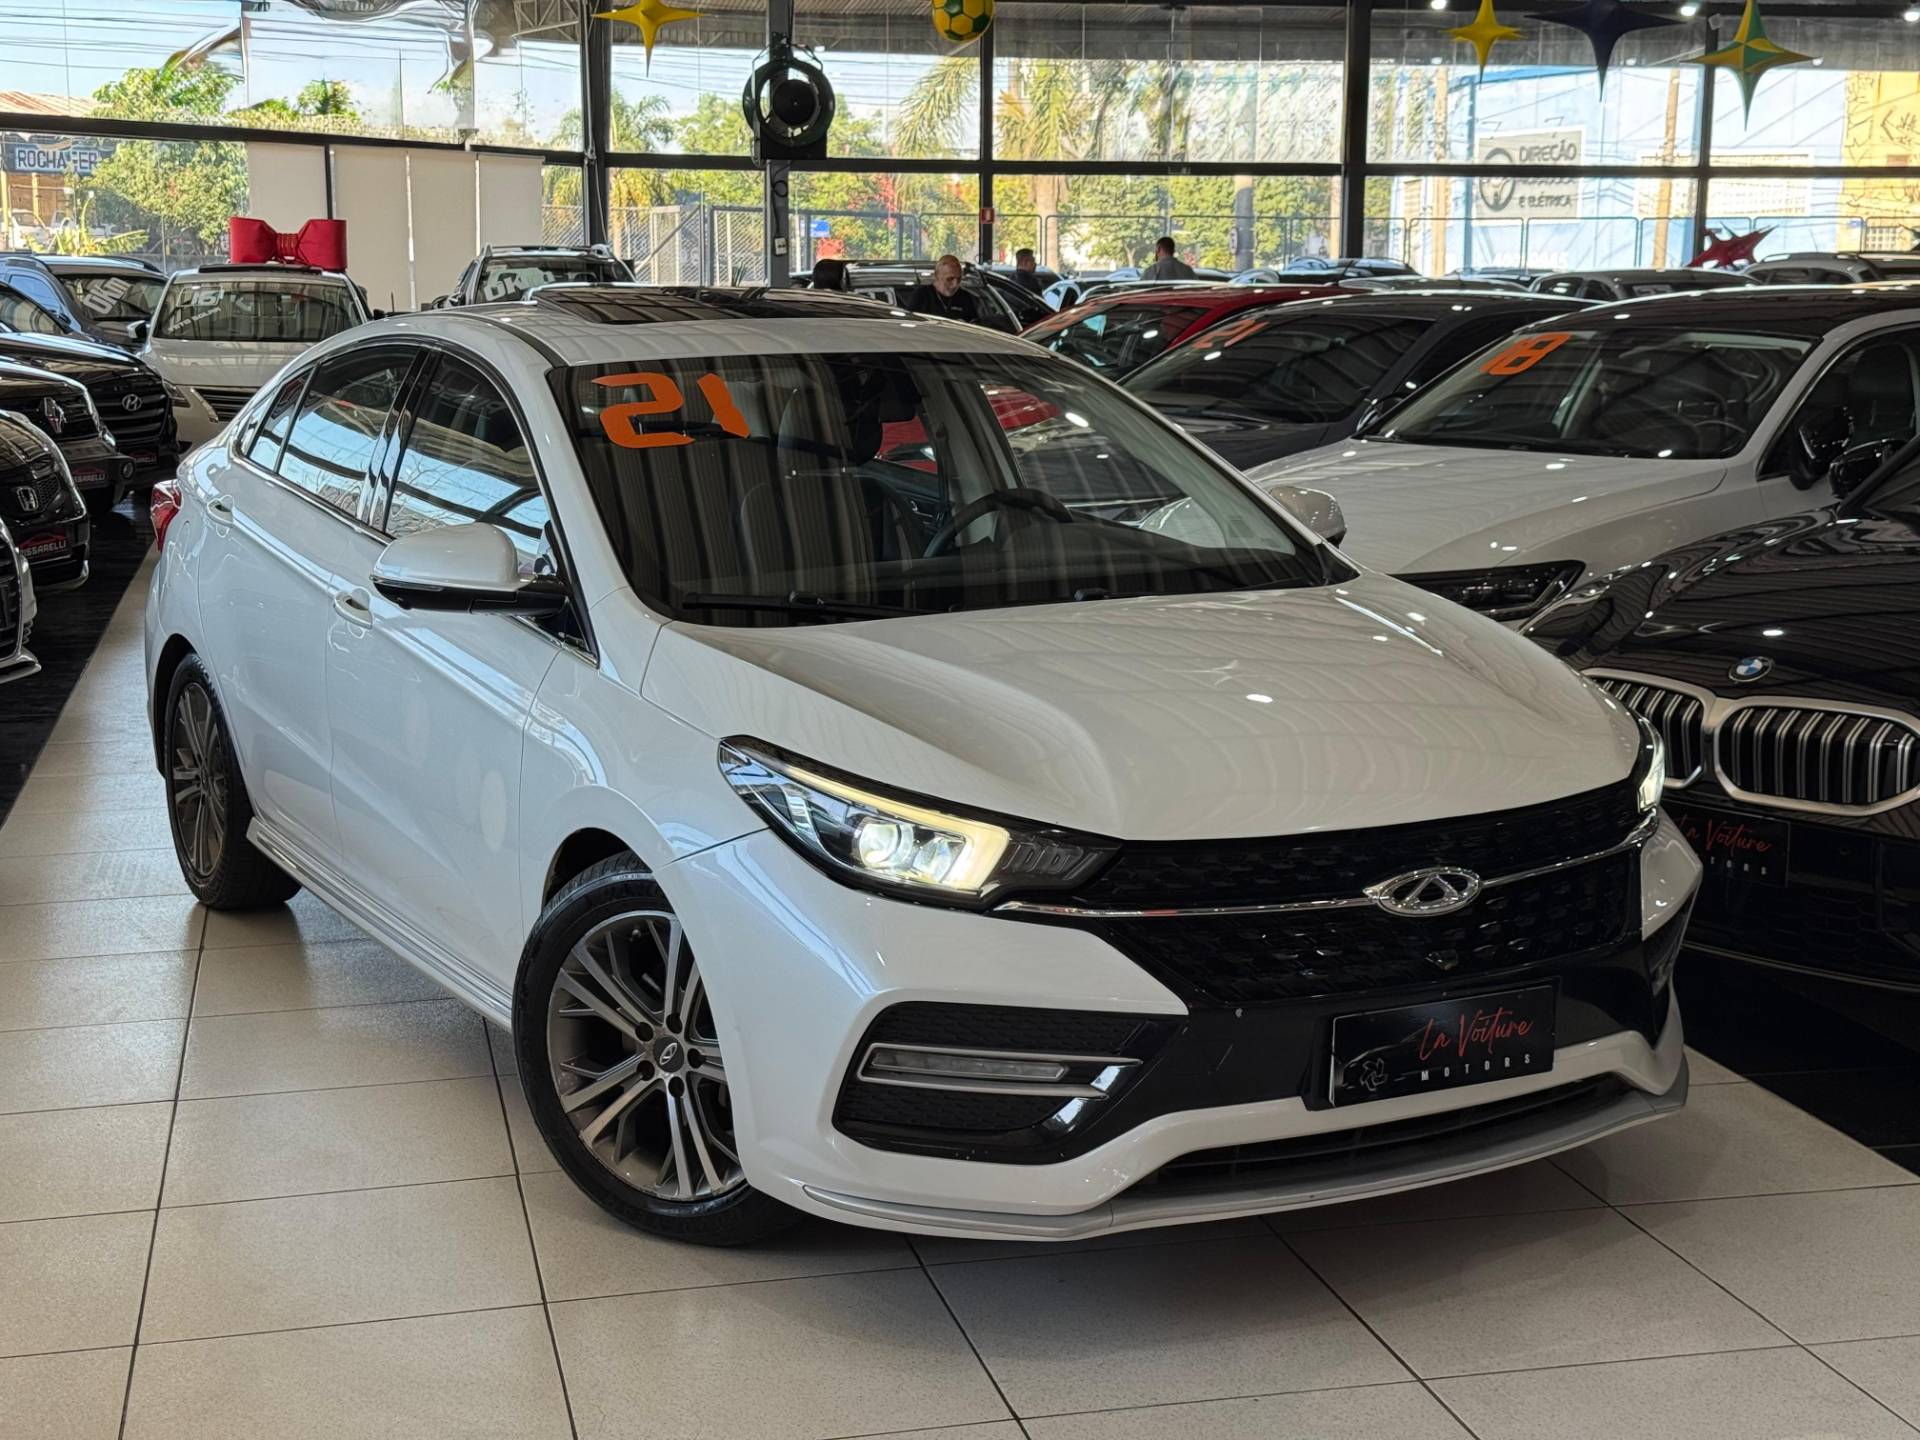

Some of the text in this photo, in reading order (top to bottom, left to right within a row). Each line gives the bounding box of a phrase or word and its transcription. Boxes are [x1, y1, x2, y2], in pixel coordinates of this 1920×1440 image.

[591, 371, 751, 449] 21
[1457, 1007, 1536, 1057] Voiture
[1420, 1053, 1531, 1081] MOTORS
